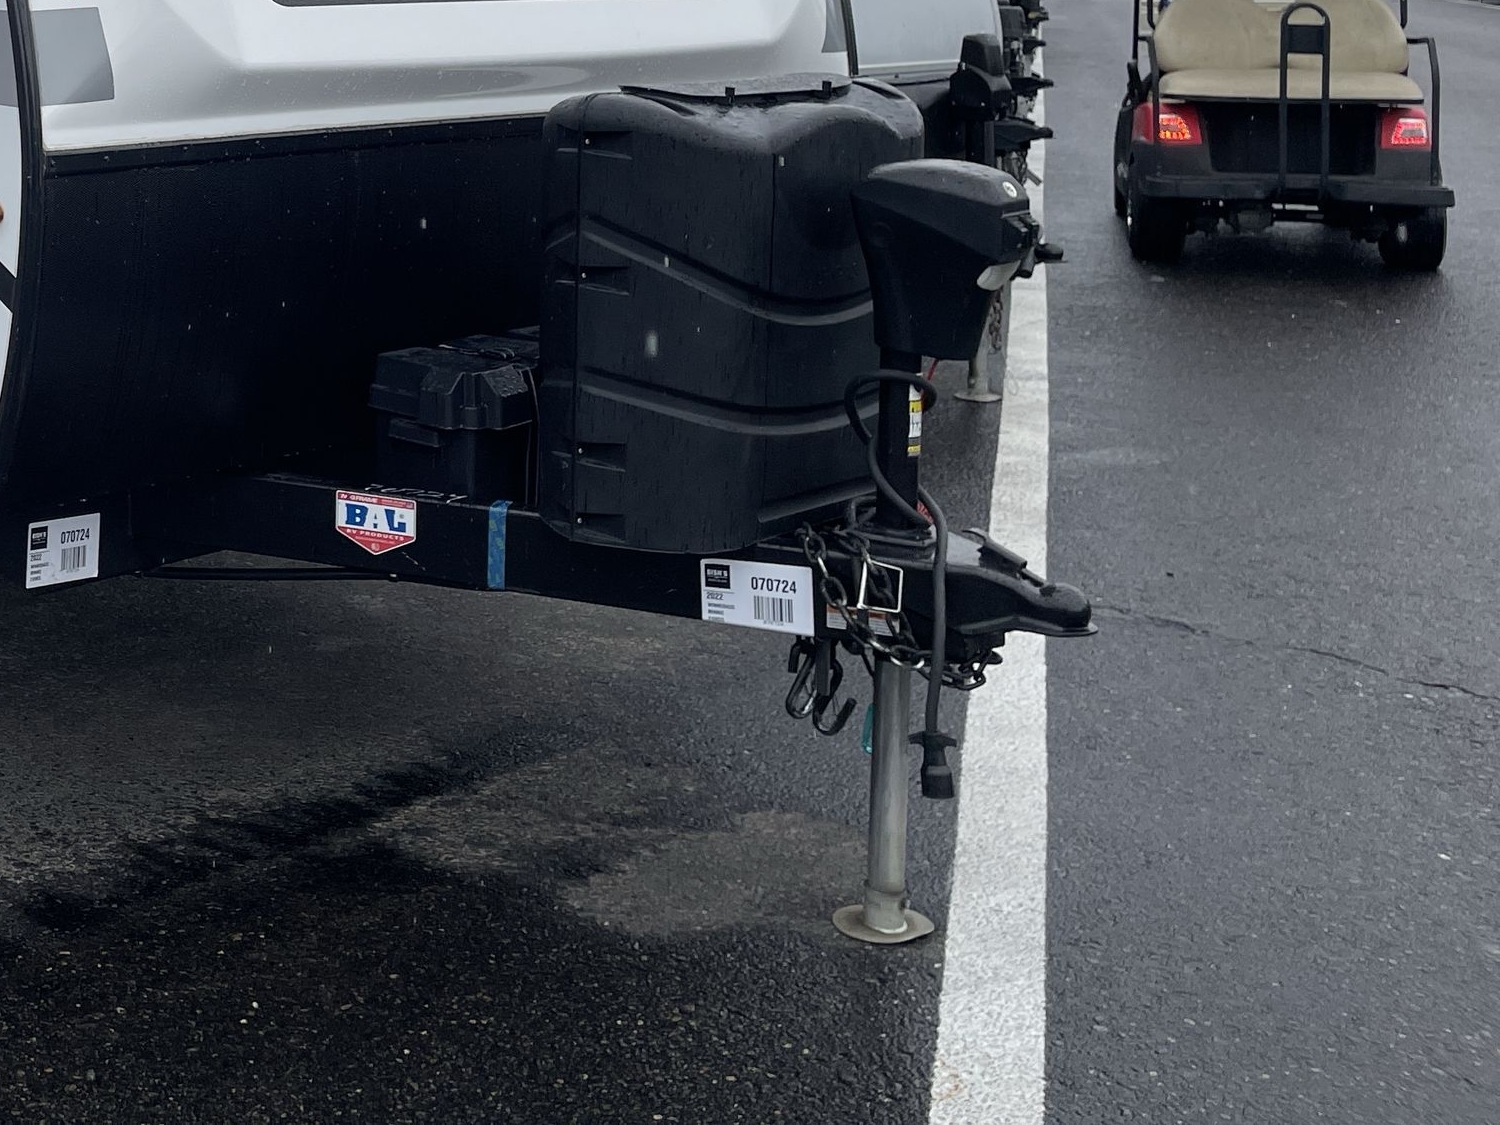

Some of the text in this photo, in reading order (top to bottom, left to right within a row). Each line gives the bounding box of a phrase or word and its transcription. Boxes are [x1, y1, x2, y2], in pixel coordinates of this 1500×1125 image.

[345, 503, 406, 532] BAL
[60, 528, 90, 544] 070724
[359, 530, 405, 542] PRODUCTS
[751, 576, 797, 595] 070724
